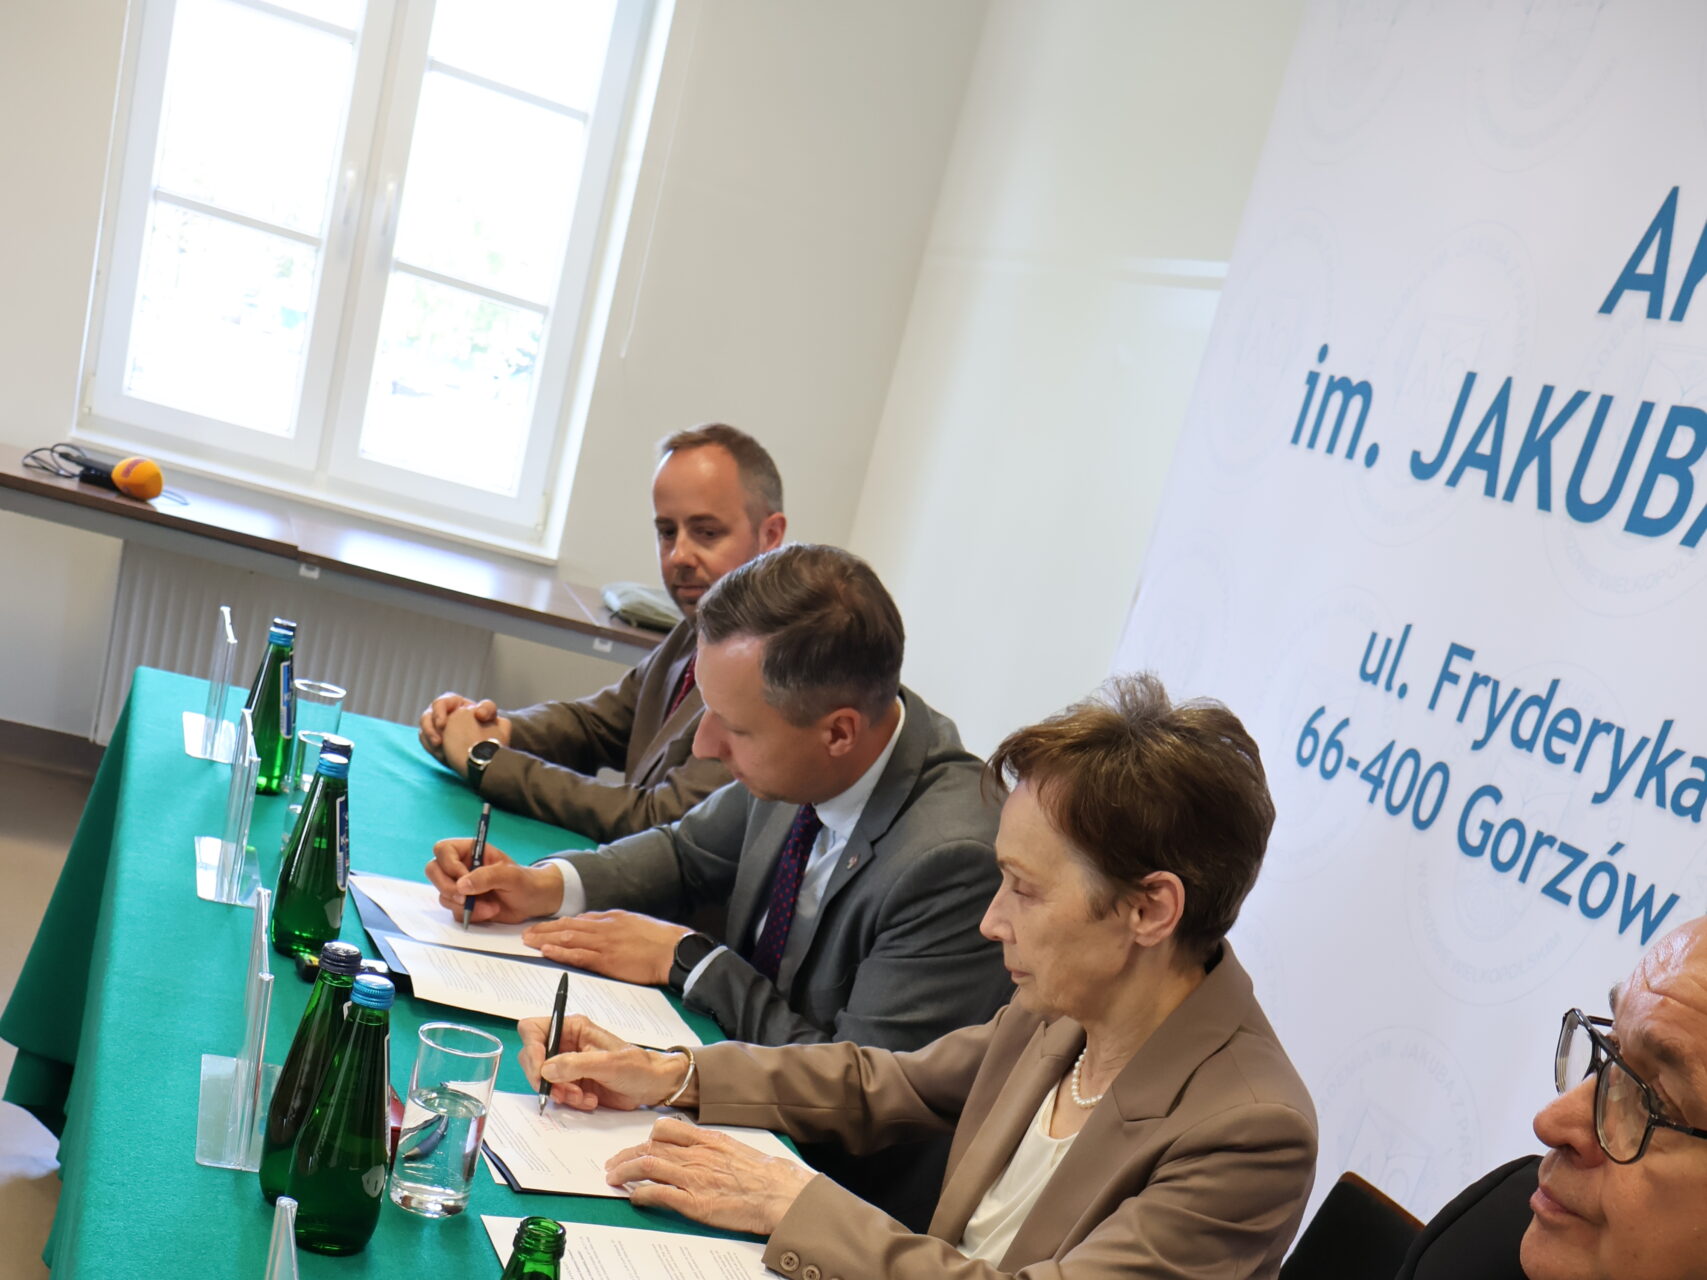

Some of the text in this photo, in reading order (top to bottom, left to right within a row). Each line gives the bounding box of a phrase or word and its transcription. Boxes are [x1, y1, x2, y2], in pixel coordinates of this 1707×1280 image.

[1290, 343, 1380, 469] im.
[1359, 623, 1707, 824] ul. Fryderyka
[1296, 706, 1450, 831] 66-400
[1457, 784, 1680, 945] Gorzów
